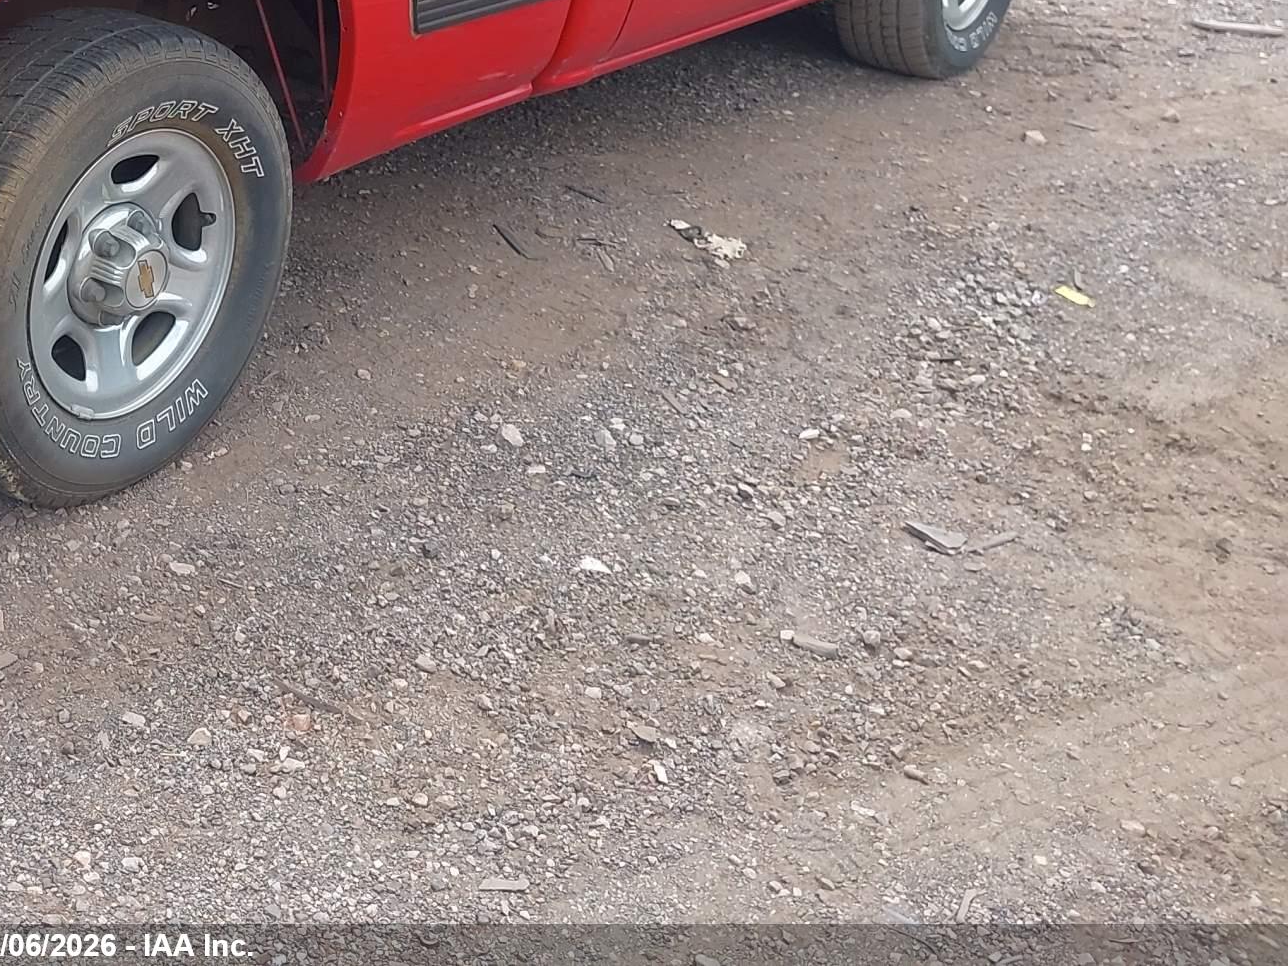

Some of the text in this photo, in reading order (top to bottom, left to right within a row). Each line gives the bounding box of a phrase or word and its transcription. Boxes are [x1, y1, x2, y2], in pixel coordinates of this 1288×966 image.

[107, 100, 264, 178] SPORT XHT
[17, 358, 209, 459] WILD COUNTRY
